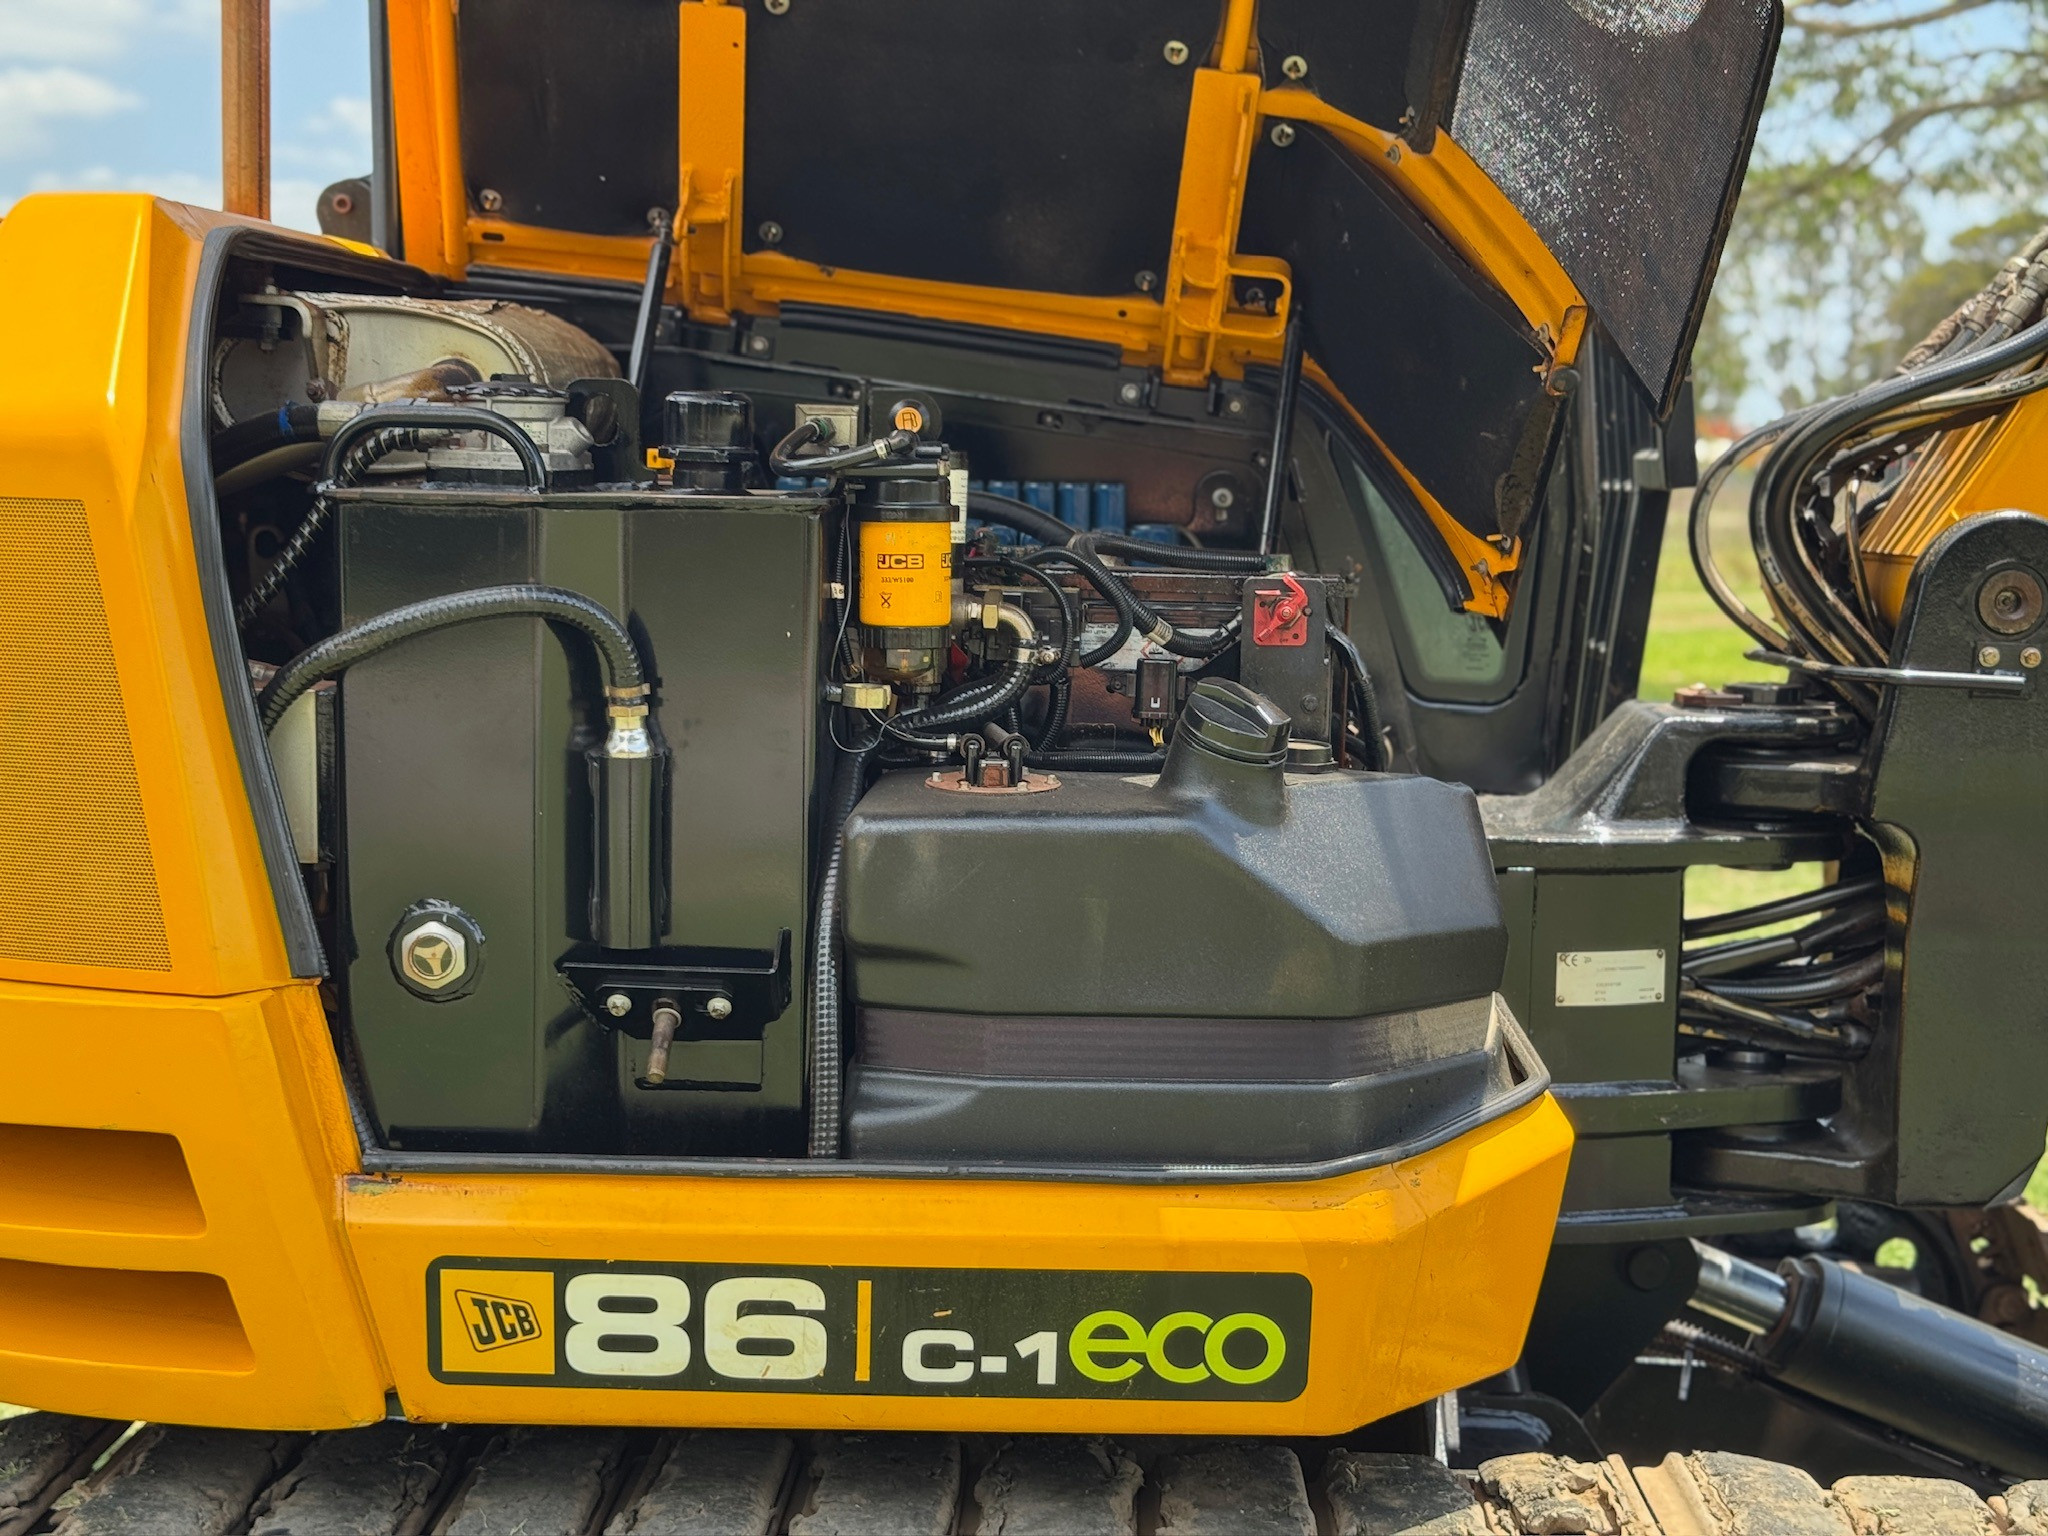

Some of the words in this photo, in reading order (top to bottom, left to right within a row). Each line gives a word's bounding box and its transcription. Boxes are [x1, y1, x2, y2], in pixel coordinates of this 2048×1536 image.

[878, 554, 924, 569] JCB
[470, 1297, 535, 1345] JCB
[564, 1273, 828, 1380] 86
[1068, 1310, 1287, 1384] eco
